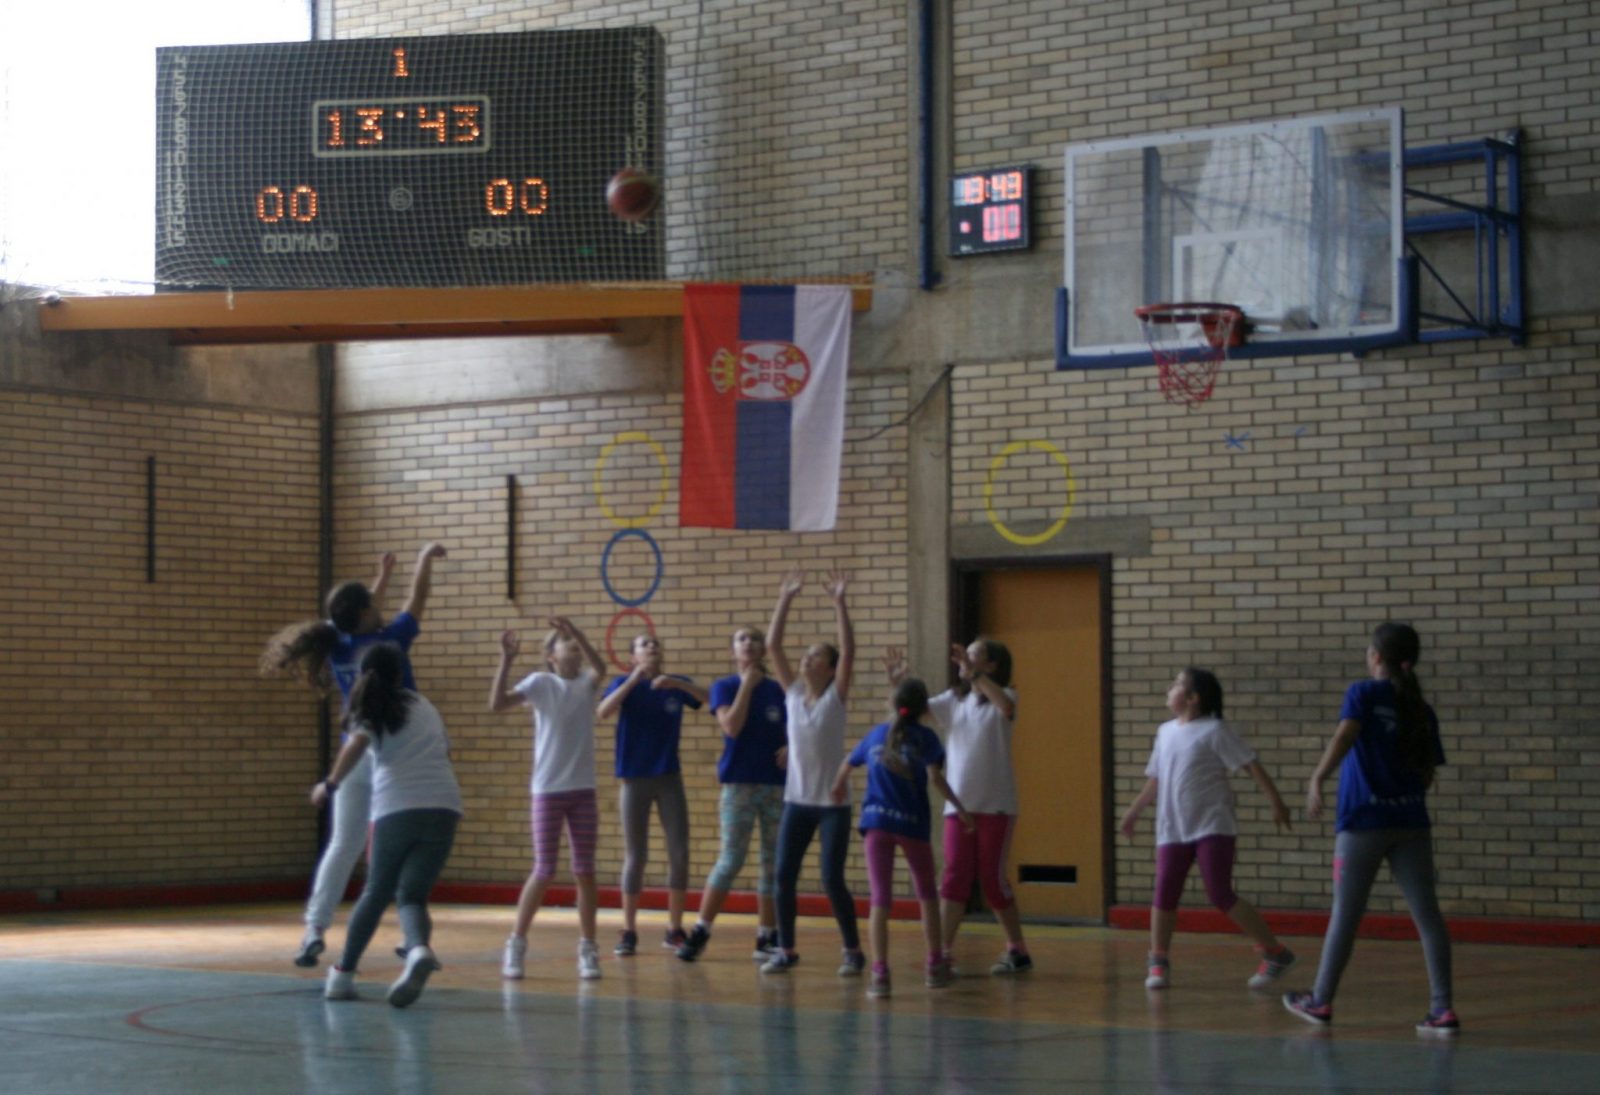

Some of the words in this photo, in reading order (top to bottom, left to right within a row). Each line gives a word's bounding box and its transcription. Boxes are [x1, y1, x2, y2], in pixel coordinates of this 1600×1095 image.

[393, 47, 408, 77] 1
[174, 70, 186, 85] 5
[175, 102, 187, 117] 7
[633, 102, 647, 118] 8
[175, 118, 186, 132] 8
[633, 119, 647, 134] 9
[175, 134, 186, 150] 9
[625, 136, 647, 151] 10
[166, 151, 186, 166] 10
[166, 167, 183, 182] 11
[166, 183, 186, 198] 12
[486, 178, 549, 214] 00
[166, 199, 186, 214] 13
[257, 186, 318, 222] 00
[166, 231, 186, 248] 15
[468, 227, 531, 247] GOSTI
